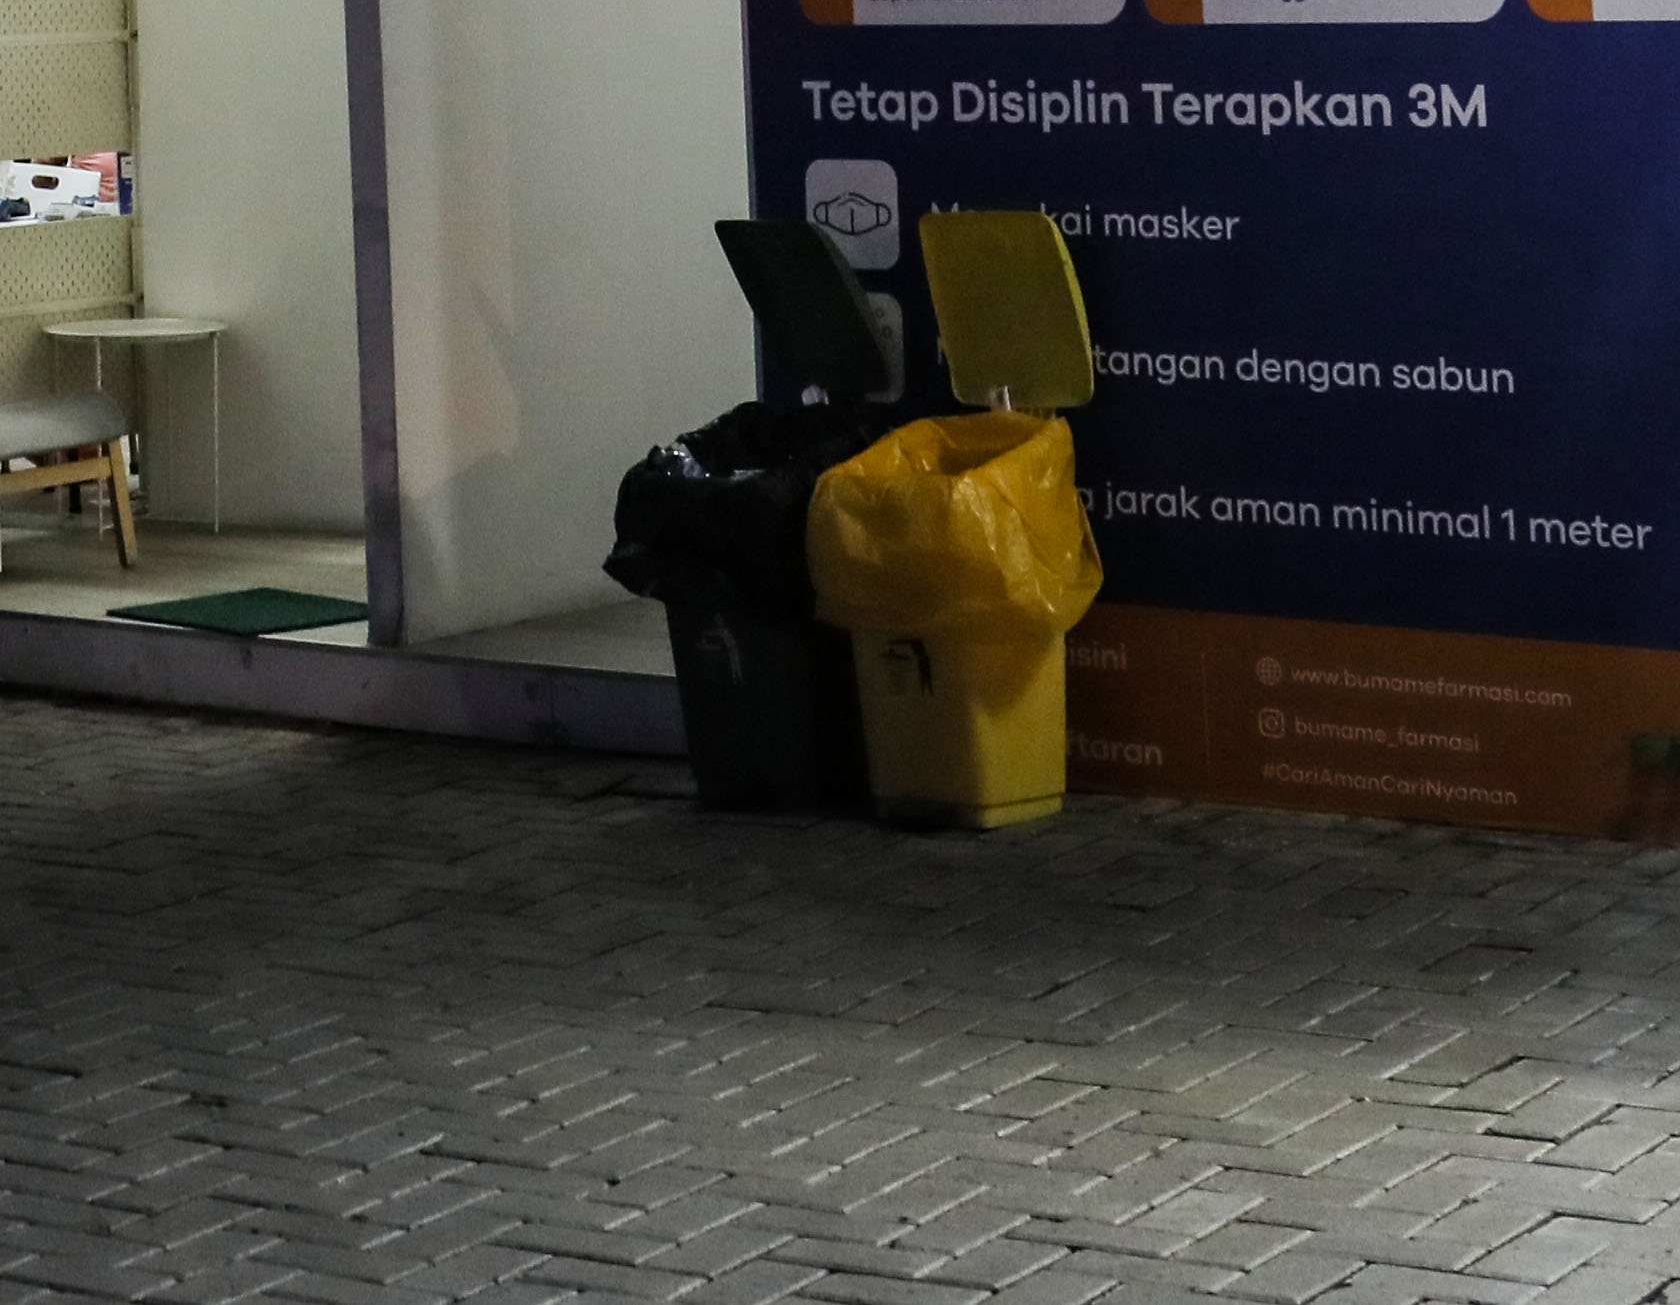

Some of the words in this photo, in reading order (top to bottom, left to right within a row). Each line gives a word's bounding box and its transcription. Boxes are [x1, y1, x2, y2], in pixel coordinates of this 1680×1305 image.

[802, 81, 939, 131] Tetap
[952, 81, 1130, 132] Disiplin
[1142, 81, 1394, 136] Terapkan
[1407, 83, 1488, 128] 3M
[1104, 205, 1240, 241] masker
[1093, 346, 1225, 386] tangan
[1236, 348, 1381, 393] dengan
[1393, 357, 1516, 395] sabun
[1104, 481, 1201, 520] jarak
[1211, 497, 1322, 528] aman
[1332, 502, 1491, 540] minimal
[1500, 509, 1516, 541] 1
[1528, 513, 1653, 550] meter
[1290, 668, 1572, 709] www.bumamefarmasi.com
[1294, 716, 1480, 753] bumame_farmasi
[1262, 761, 1518, 807] #CariAmanCariNyaman
